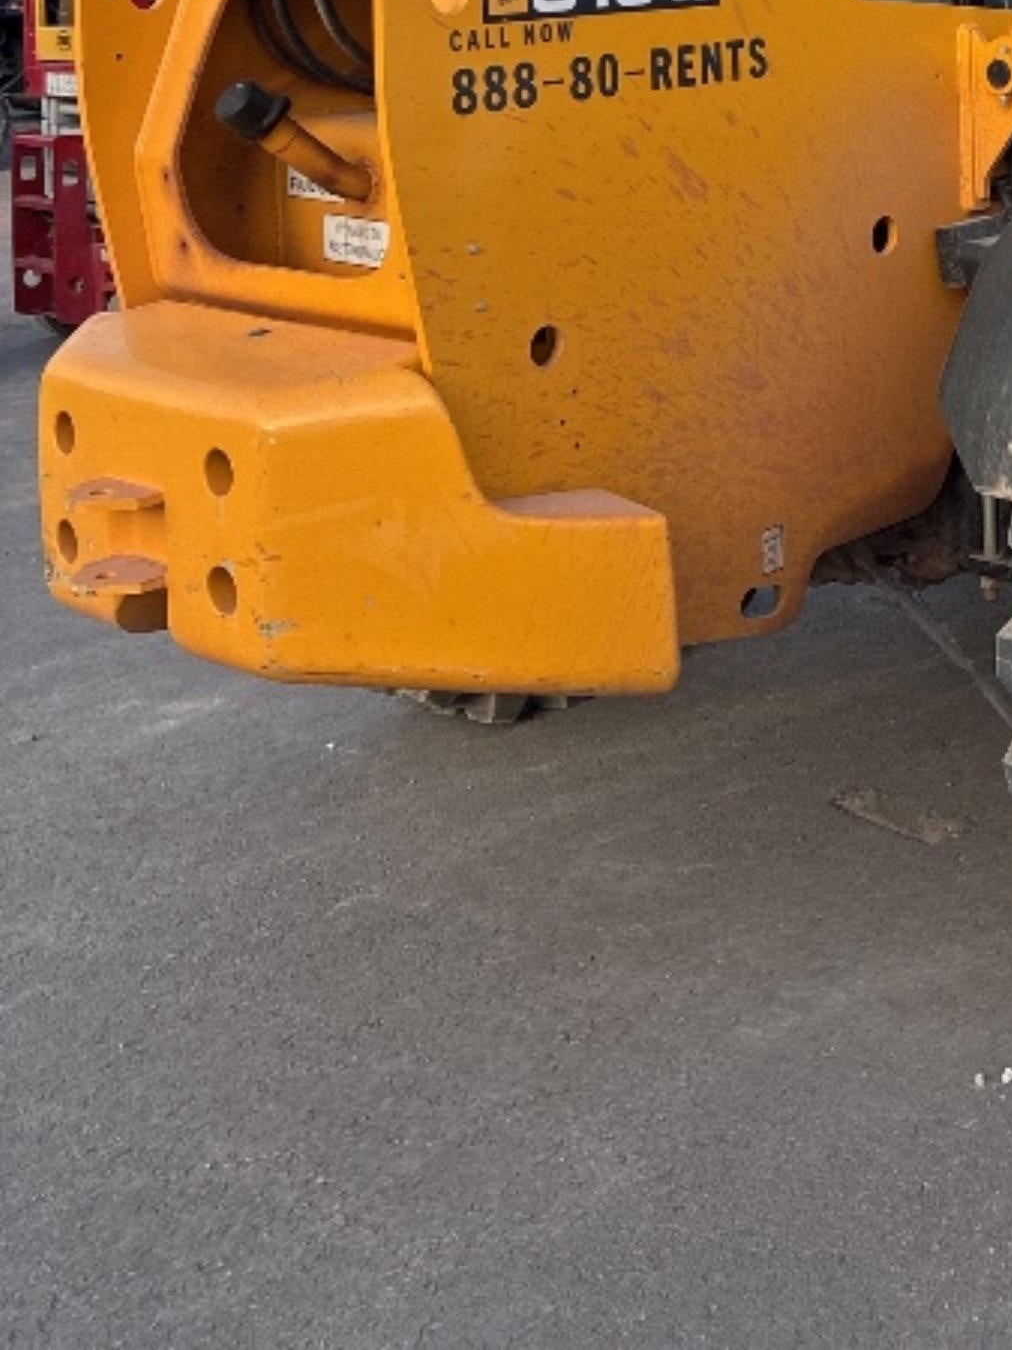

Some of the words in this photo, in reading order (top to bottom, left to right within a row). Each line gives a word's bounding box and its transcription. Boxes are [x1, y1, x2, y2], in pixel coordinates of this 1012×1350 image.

[449, 28, 511, 51] CALL
[524, 21, 573, 46] NOW
[452, 36, 767, 116] 888-80-RENTS
